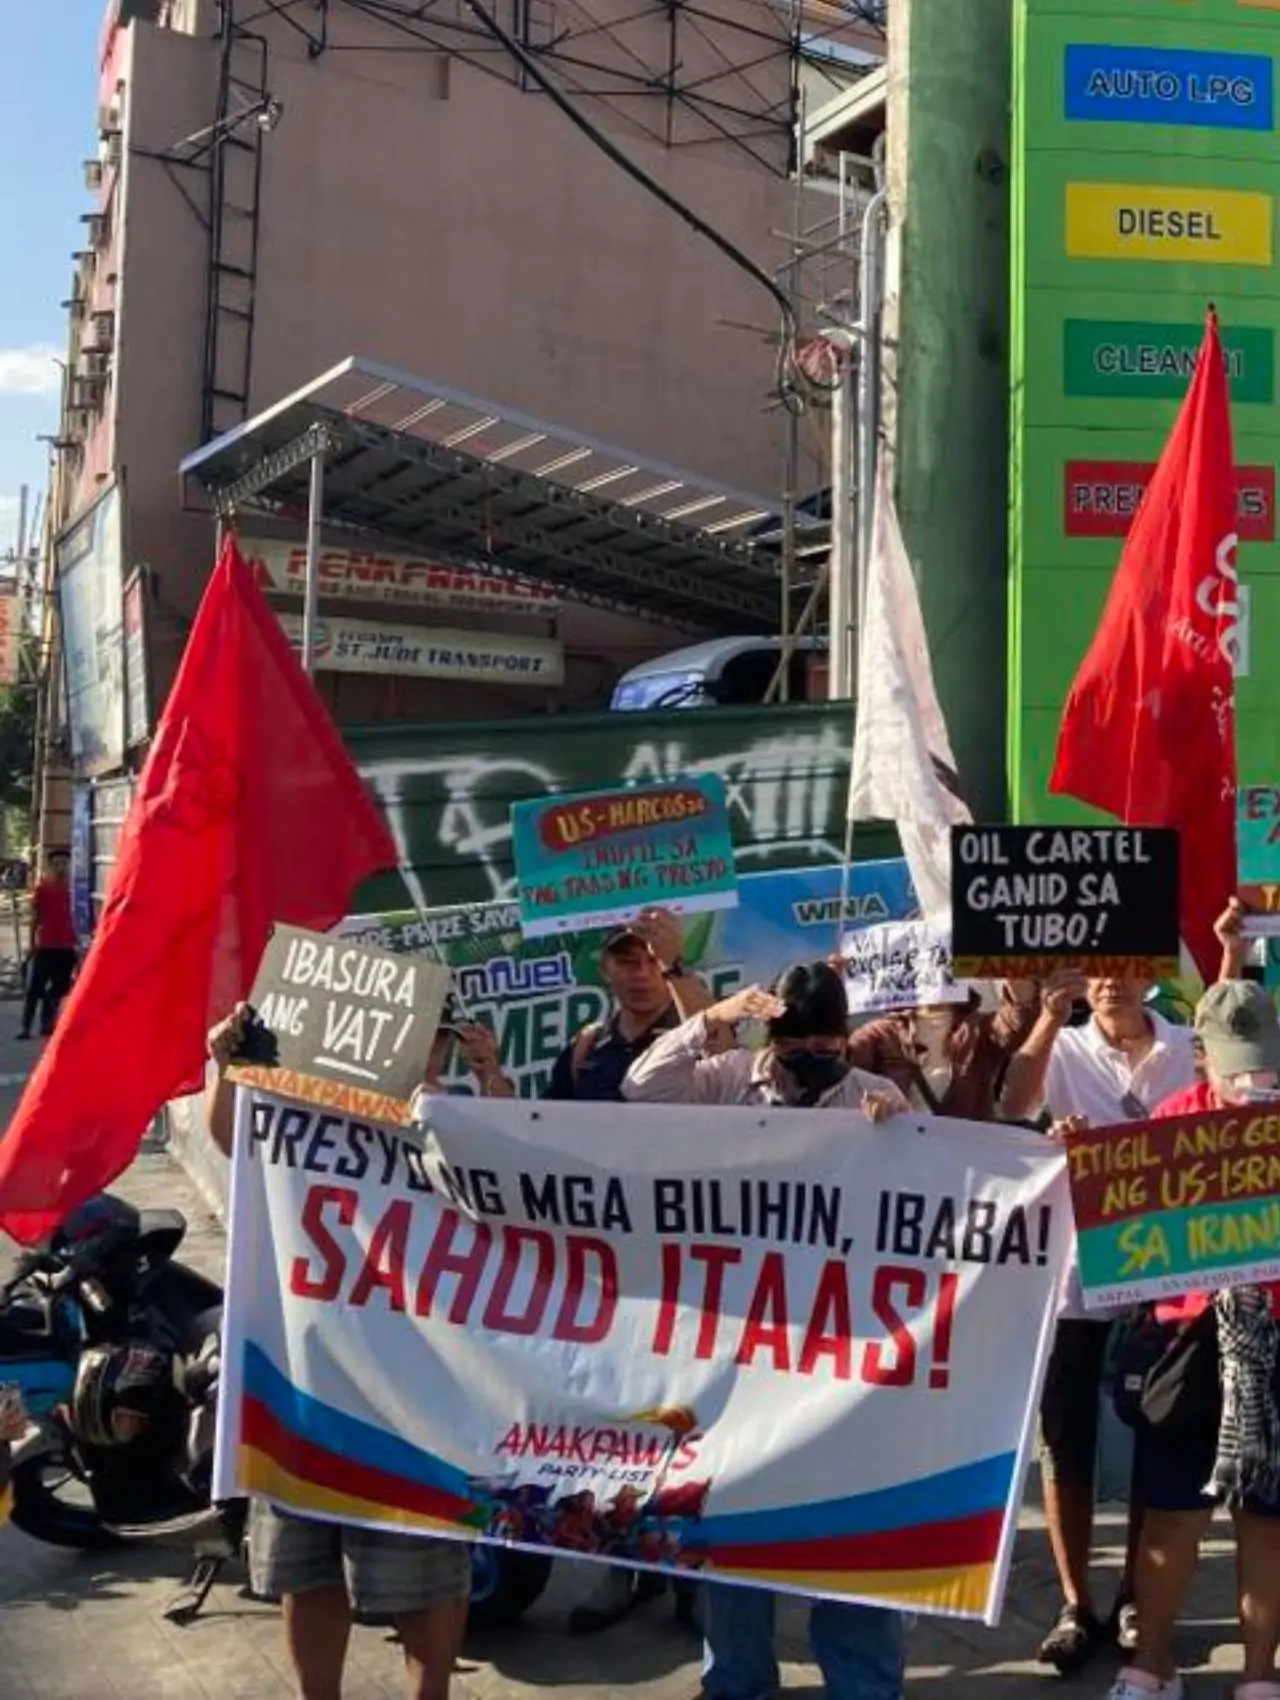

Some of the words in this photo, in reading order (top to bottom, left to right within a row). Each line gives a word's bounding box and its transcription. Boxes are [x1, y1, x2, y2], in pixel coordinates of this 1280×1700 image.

[1089, 69, 1179, 99] AUTO
[1189, 75, 1254, 105] LPG
[1118, 208, 1222, 240] DIESEL
[960, 833, 1010, 865] OIL
[1025, 831, 1152, 865] CARTEL
[966, 873, 1068, 912] GANID
[1078, 872, 1122, 907] SA
[996, 912, 1108, 948] TUBO!
[281, 937, 418, 1008] IBASURA
[254, 991, 309, 1037] ANG
[321, 1000, 415, 1069] VAT!
[1070, 1134, 1161, 1181] ITIGIL
[1172, 1118, 1239, 1158] ANG
[248, 1102, 434, 1193] PRESYO
[437, 1160, 506, 1218] NG
[520, 1171, 632, 1233] MGA
[653, 1178, 855, 1255] BILIHIN,
[875, 1189, 1052, 1267] IBABA!
[1101, 1176, 1148, 1216] NG
[1116, 1220, 1171, 1275] SA
[289, 1184, 620, 1344] SAHOD
[652, 1242, 960, 1390] ITAAS!
